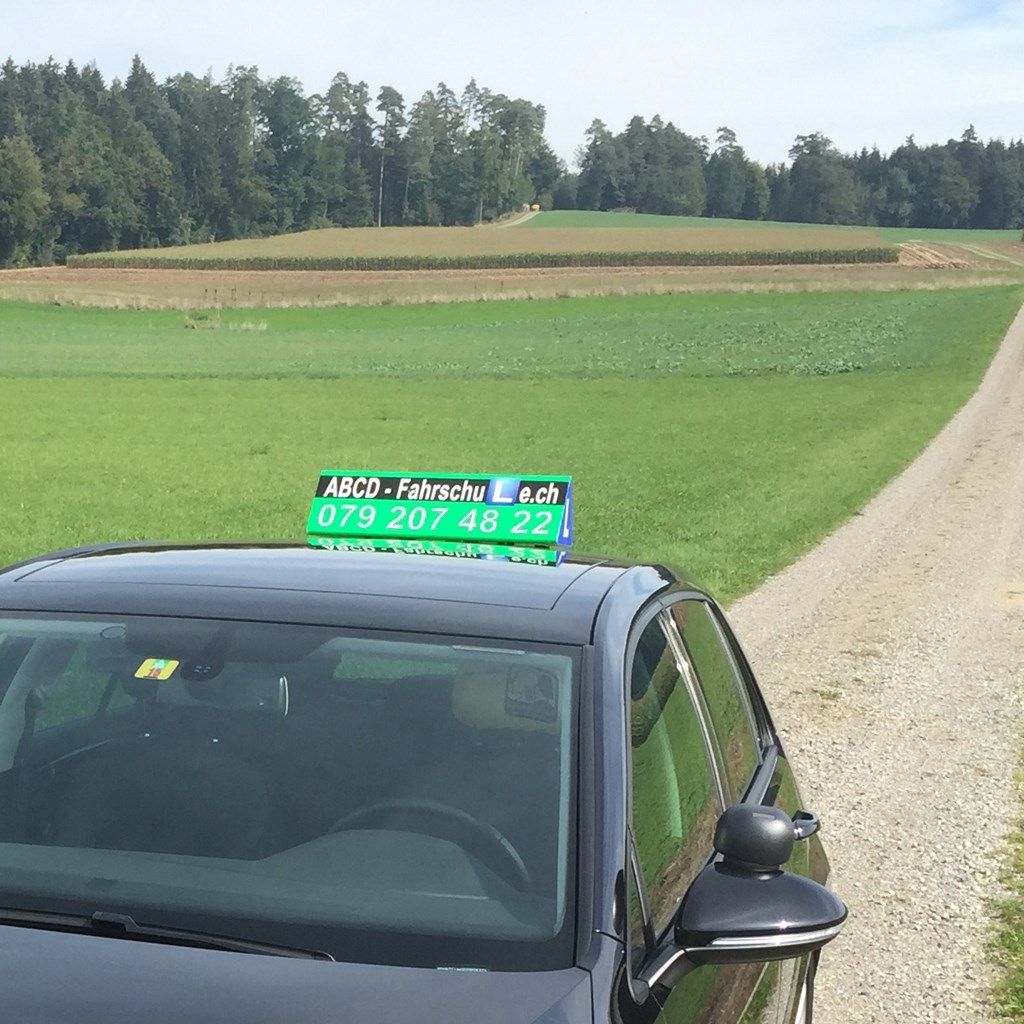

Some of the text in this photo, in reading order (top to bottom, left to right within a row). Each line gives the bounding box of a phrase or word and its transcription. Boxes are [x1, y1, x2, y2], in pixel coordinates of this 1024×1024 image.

[323, 476, 380, 499] ABCD
[317, 503, 553, 535] 079 207 48 22
